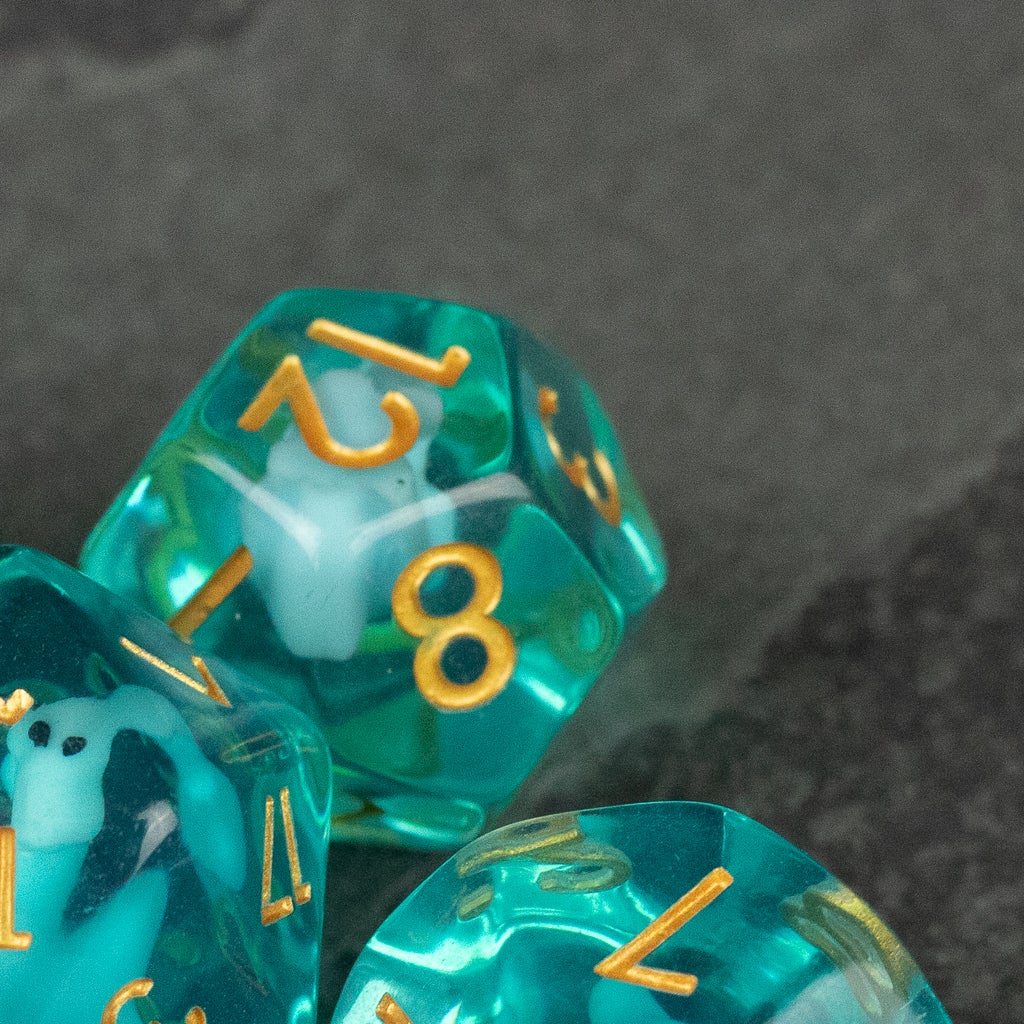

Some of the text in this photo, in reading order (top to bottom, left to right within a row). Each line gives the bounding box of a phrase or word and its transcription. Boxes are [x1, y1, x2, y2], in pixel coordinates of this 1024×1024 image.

[239, 319, 470, 468] 12
[392, 543, 516, 710] 8
[261, 786, 311, 926] 17
[594, 867, 733, 996] 7
